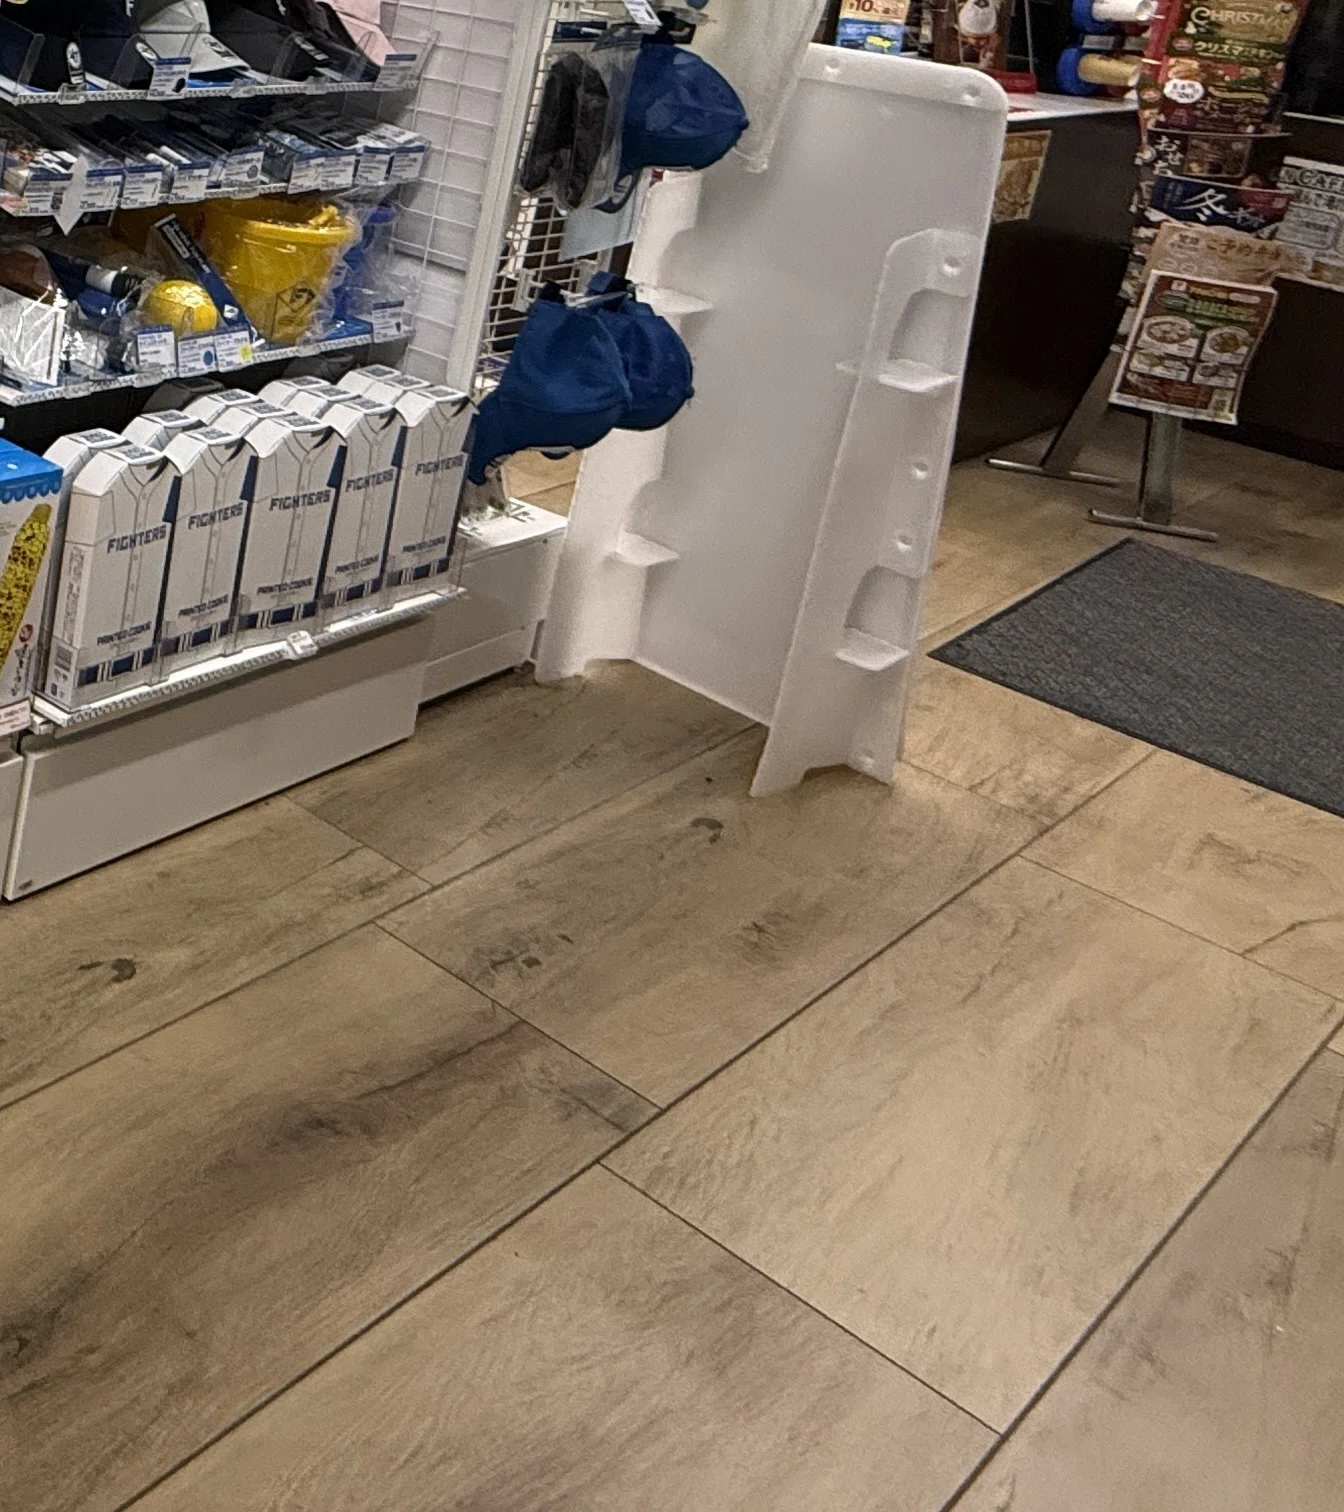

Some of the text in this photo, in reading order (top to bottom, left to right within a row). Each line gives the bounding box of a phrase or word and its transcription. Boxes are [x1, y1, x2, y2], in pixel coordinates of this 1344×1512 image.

[344, 468, 395, 493] FIGHTERS
[269, 489, 331, 512] FIGHTERS
[188, 502, 244, 529] FIGHTERS
[107, 524, 167, 553] FIGHTERS
